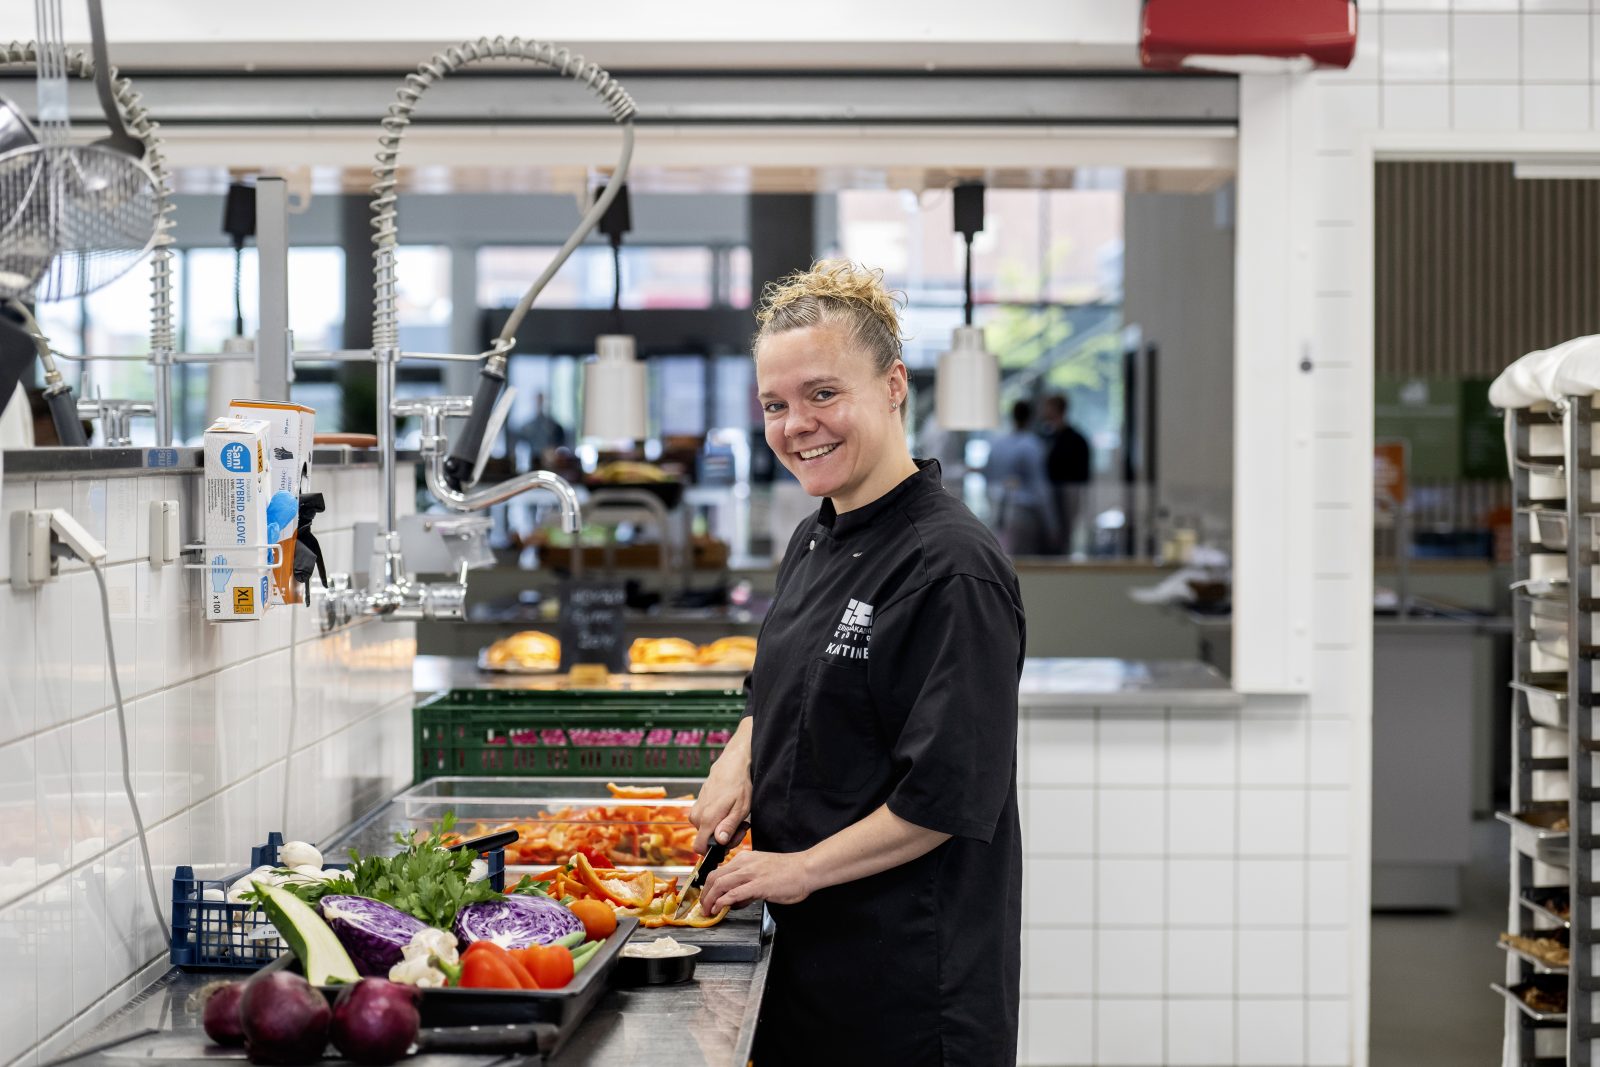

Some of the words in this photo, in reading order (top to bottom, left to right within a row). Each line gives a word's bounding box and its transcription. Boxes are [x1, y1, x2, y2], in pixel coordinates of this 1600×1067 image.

[233, 446, 244, 469] Sani
[236, 478, 246, 512] HYBRID
[236, 514, 247, 545] GLOVE
[237, 589, 249, 604] XL
